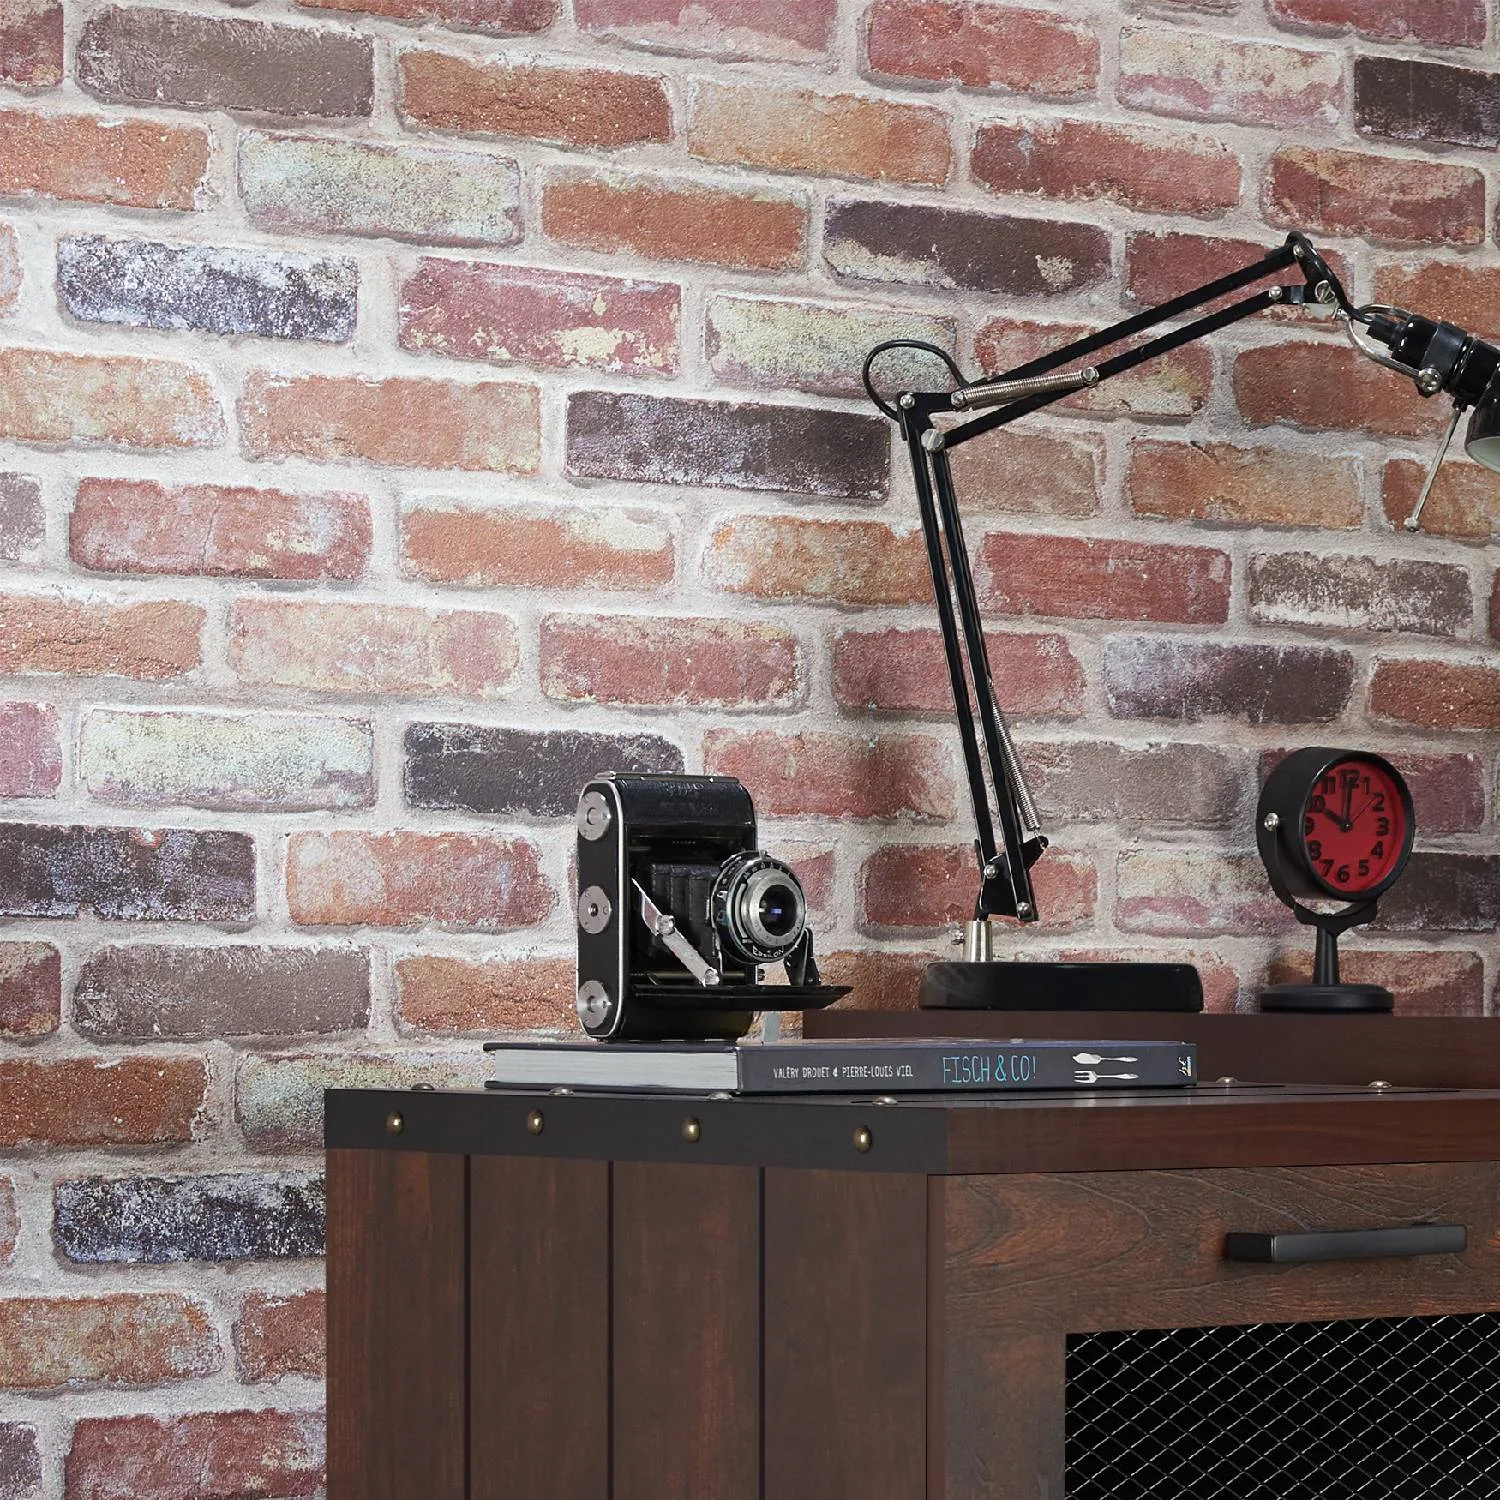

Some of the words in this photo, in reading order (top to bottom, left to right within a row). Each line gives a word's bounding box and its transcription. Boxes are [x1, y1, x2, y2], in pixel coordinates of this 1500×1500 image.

[1372, 792, 1385, 812] 2
[1376, 817, 1389, 836] 3
[1309, 840, 1322, 861] 8
[1371, 841, 1384, 859] 4
[1322, 859, 1335, 877] 7
[1337, 865, 1350, 883] 6
[1358, 859, 1370, 877] 5
[802, 1066, 830, 1078] DROUET
[842, 1065, 893, 1078] PIERRE-LOUIS
[942, 1056, 990, 1084] FISCH
[994, 1054, 1007, 1082] &
[1011, 1055, 1036, 1081] CO!
